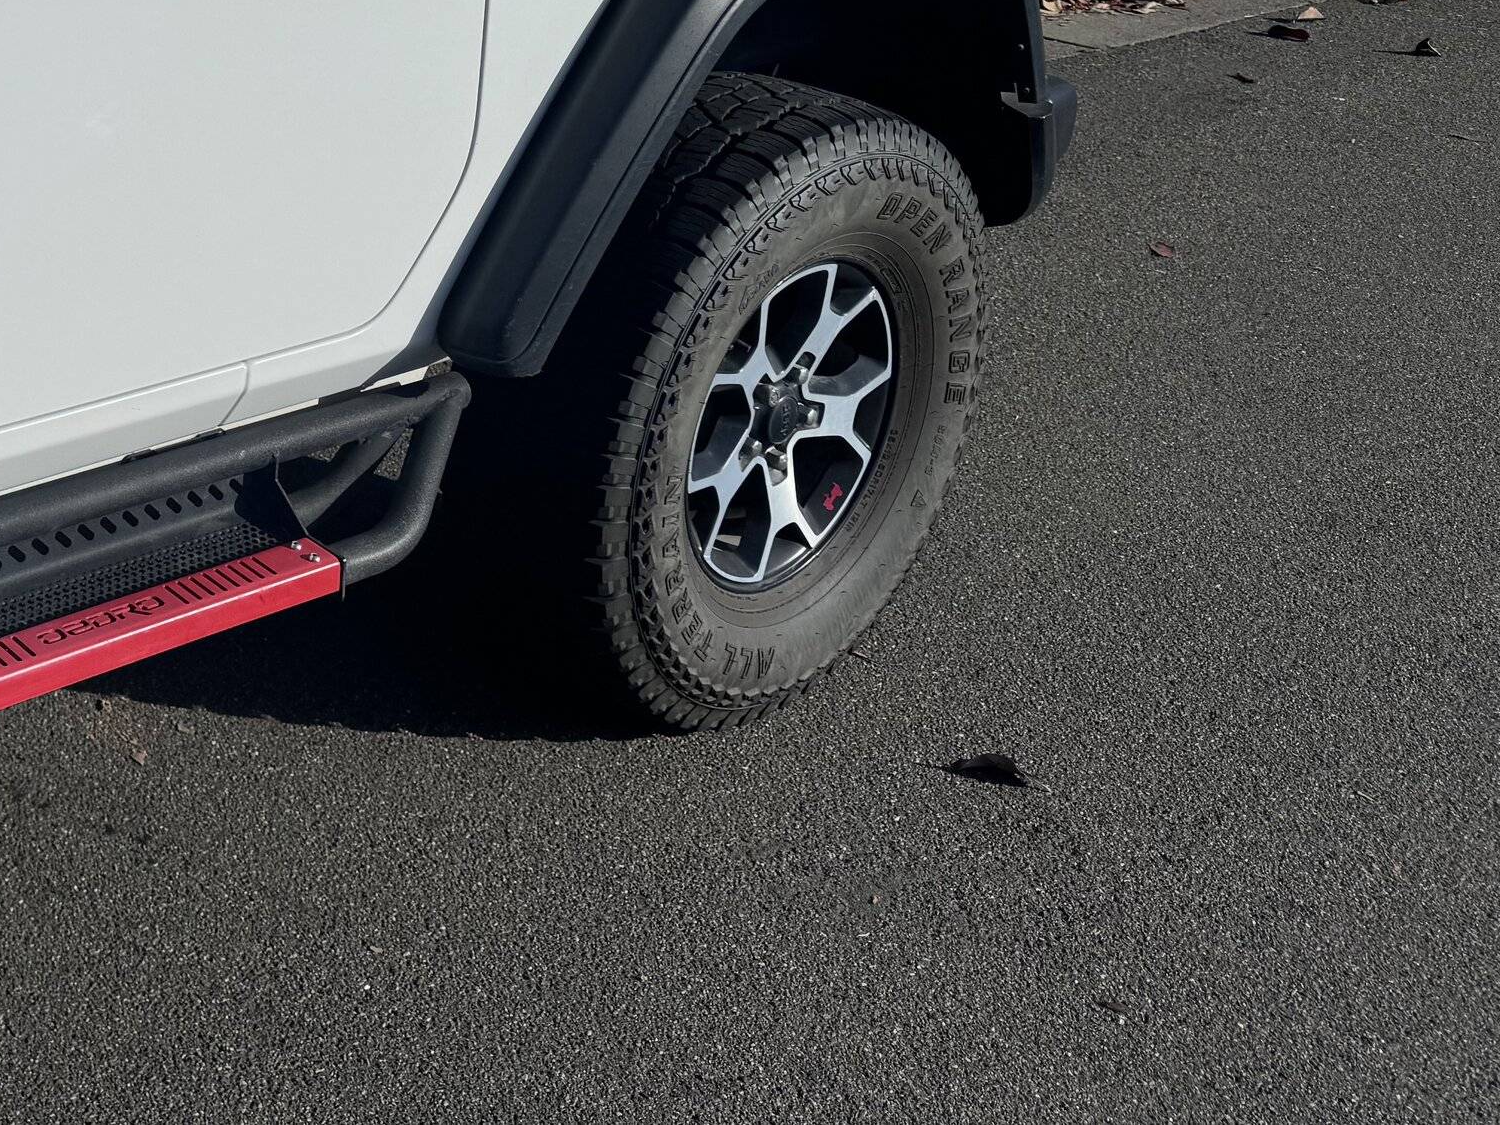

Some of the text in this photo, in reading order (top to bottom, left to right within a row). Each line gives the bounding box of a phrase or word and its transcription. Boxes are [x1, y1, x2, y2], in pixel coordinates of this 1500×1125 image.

[877, 191, 954, 254] OPEN
[939, 255, 972, 405] RANGE
[662, 473, 775, 680] ALL TERRAIN
